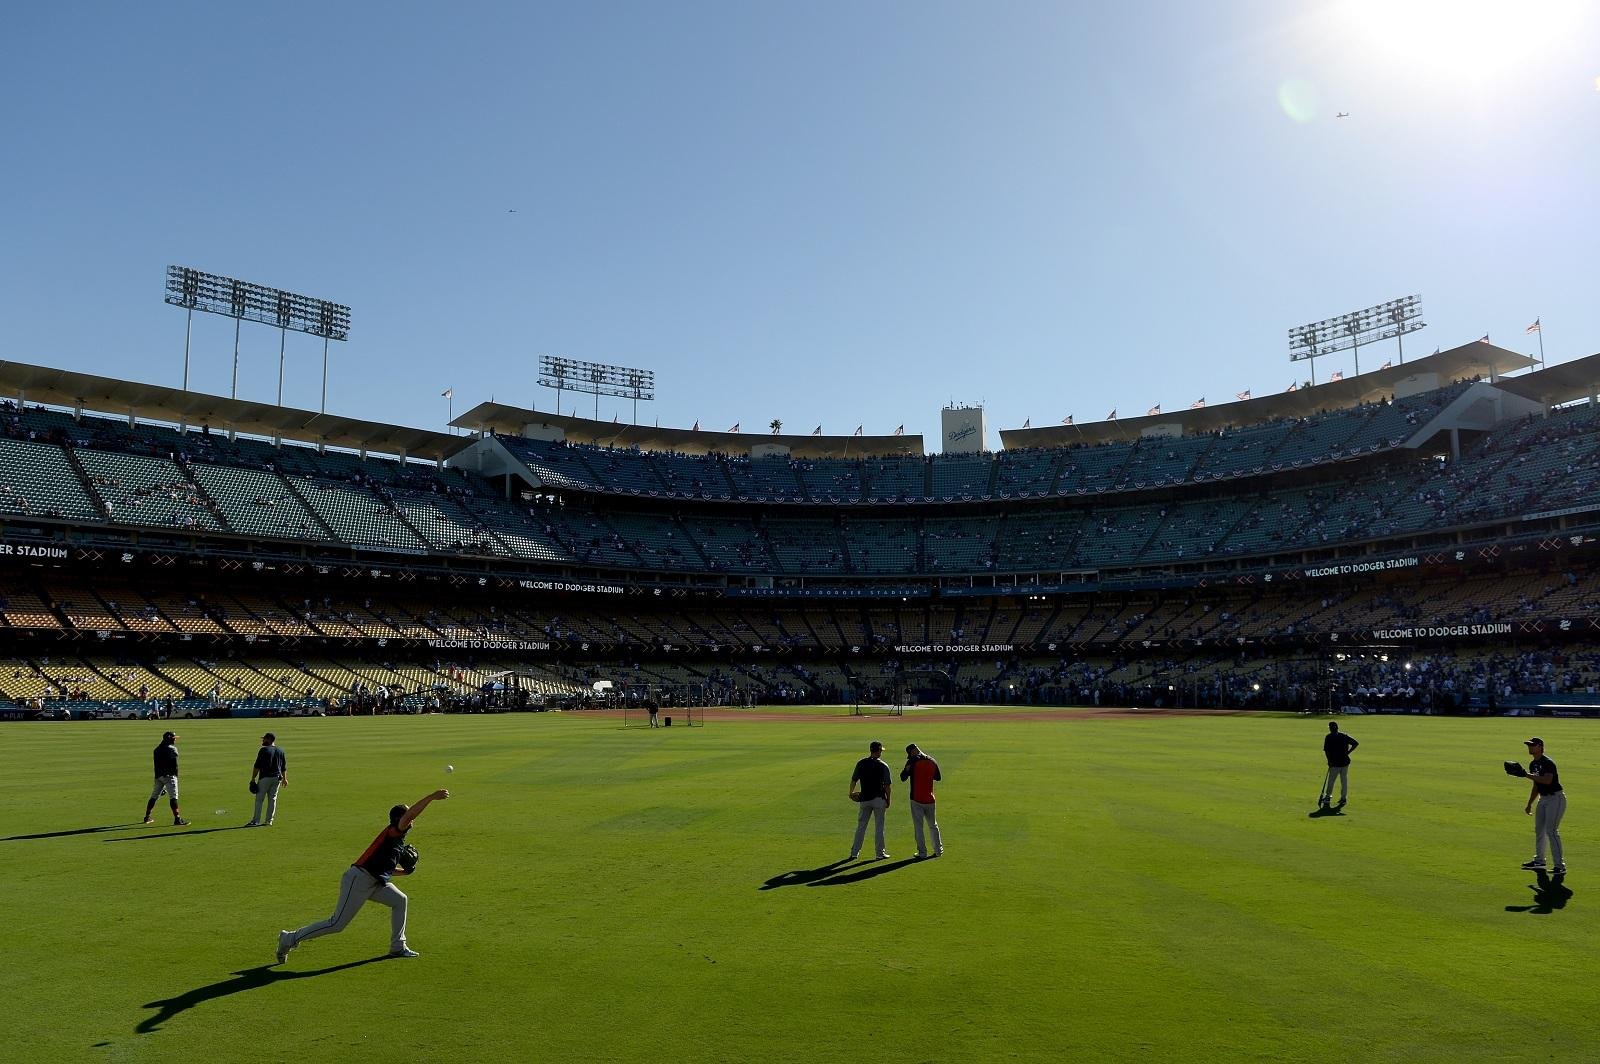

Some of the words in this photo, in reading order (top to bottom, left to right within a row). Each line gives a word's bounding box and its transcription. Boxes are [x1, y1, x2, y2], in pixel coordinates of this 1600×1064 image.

[17, 545, 68, 559] STADIUM
[1305, 566, 1339, 577] WELCOME
[1340, 565, 1351, 573] TO
[1353, 561, 1385, 573] DODGER
[1386, 557, 1418, 569] STADIUM
[519, 580, 553, 590] WELCOME
[554, 582, 564, 590] TO
[565, 583, 596, 593] DODGER
[596, 585, 624, 594] STADIUM
[1373, 629, 1412, 639] WELCOME
[1414, 628, 1427, 637] TO
[1429, 625, 1469, 637] DODGER
[1471, 623, 1512, 635] STADIUM
[428, 639, 468, 649] WELCOME
[470, 640, 481, 649] TO
[483, 641, 518, 650] DODGER
[519, 642, 550, 650] STADIUM
[894, 645, 932, 653] WELCOME
[981, 644, 1014, 652] STADIUM
